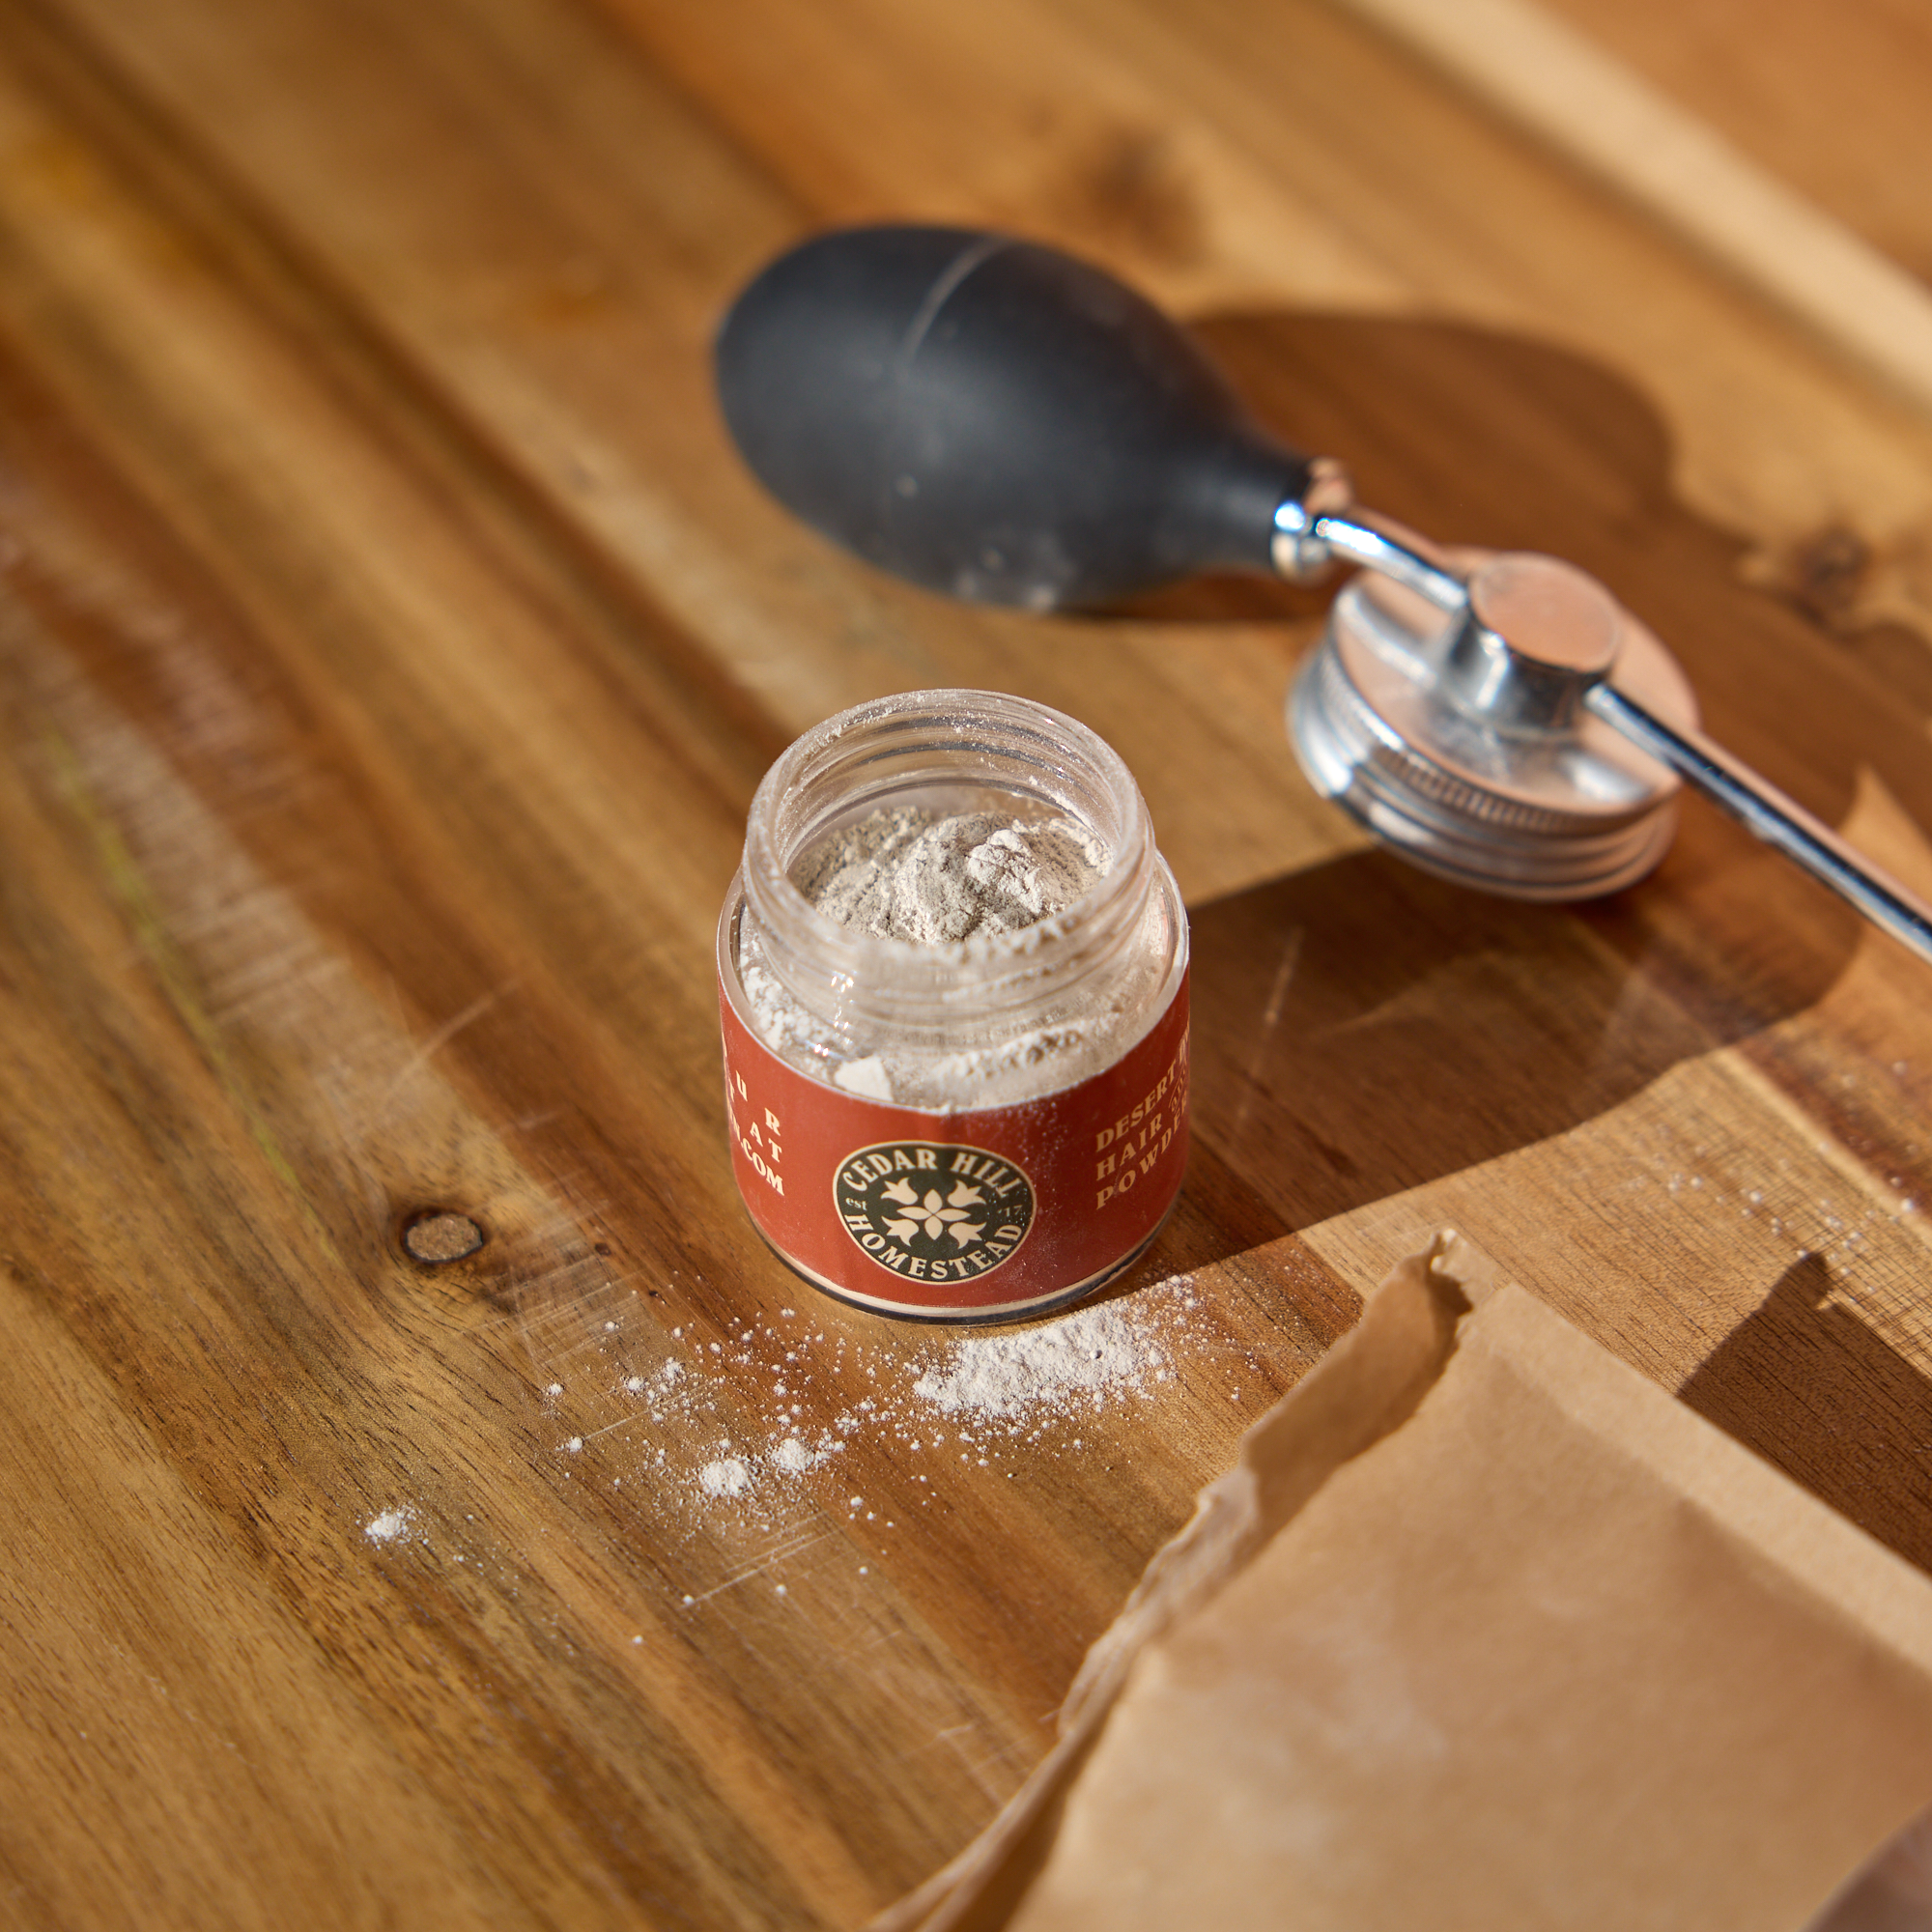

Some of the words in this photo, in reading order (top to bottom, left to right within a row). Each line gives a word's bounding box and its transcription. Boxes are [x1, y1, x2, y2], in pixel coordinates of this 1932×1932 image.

[1095, 1059, 1177, 1152] DESERT
[842, 1149, 938, 1192] CEDAR
[950, 1151, 1023, 1199] HILL
[1095, 1113, 1163, 1181] HAIR
[845, 1197, 868, 1211] est
[843, 1213, 1023, 1280] HOMESTEAD
